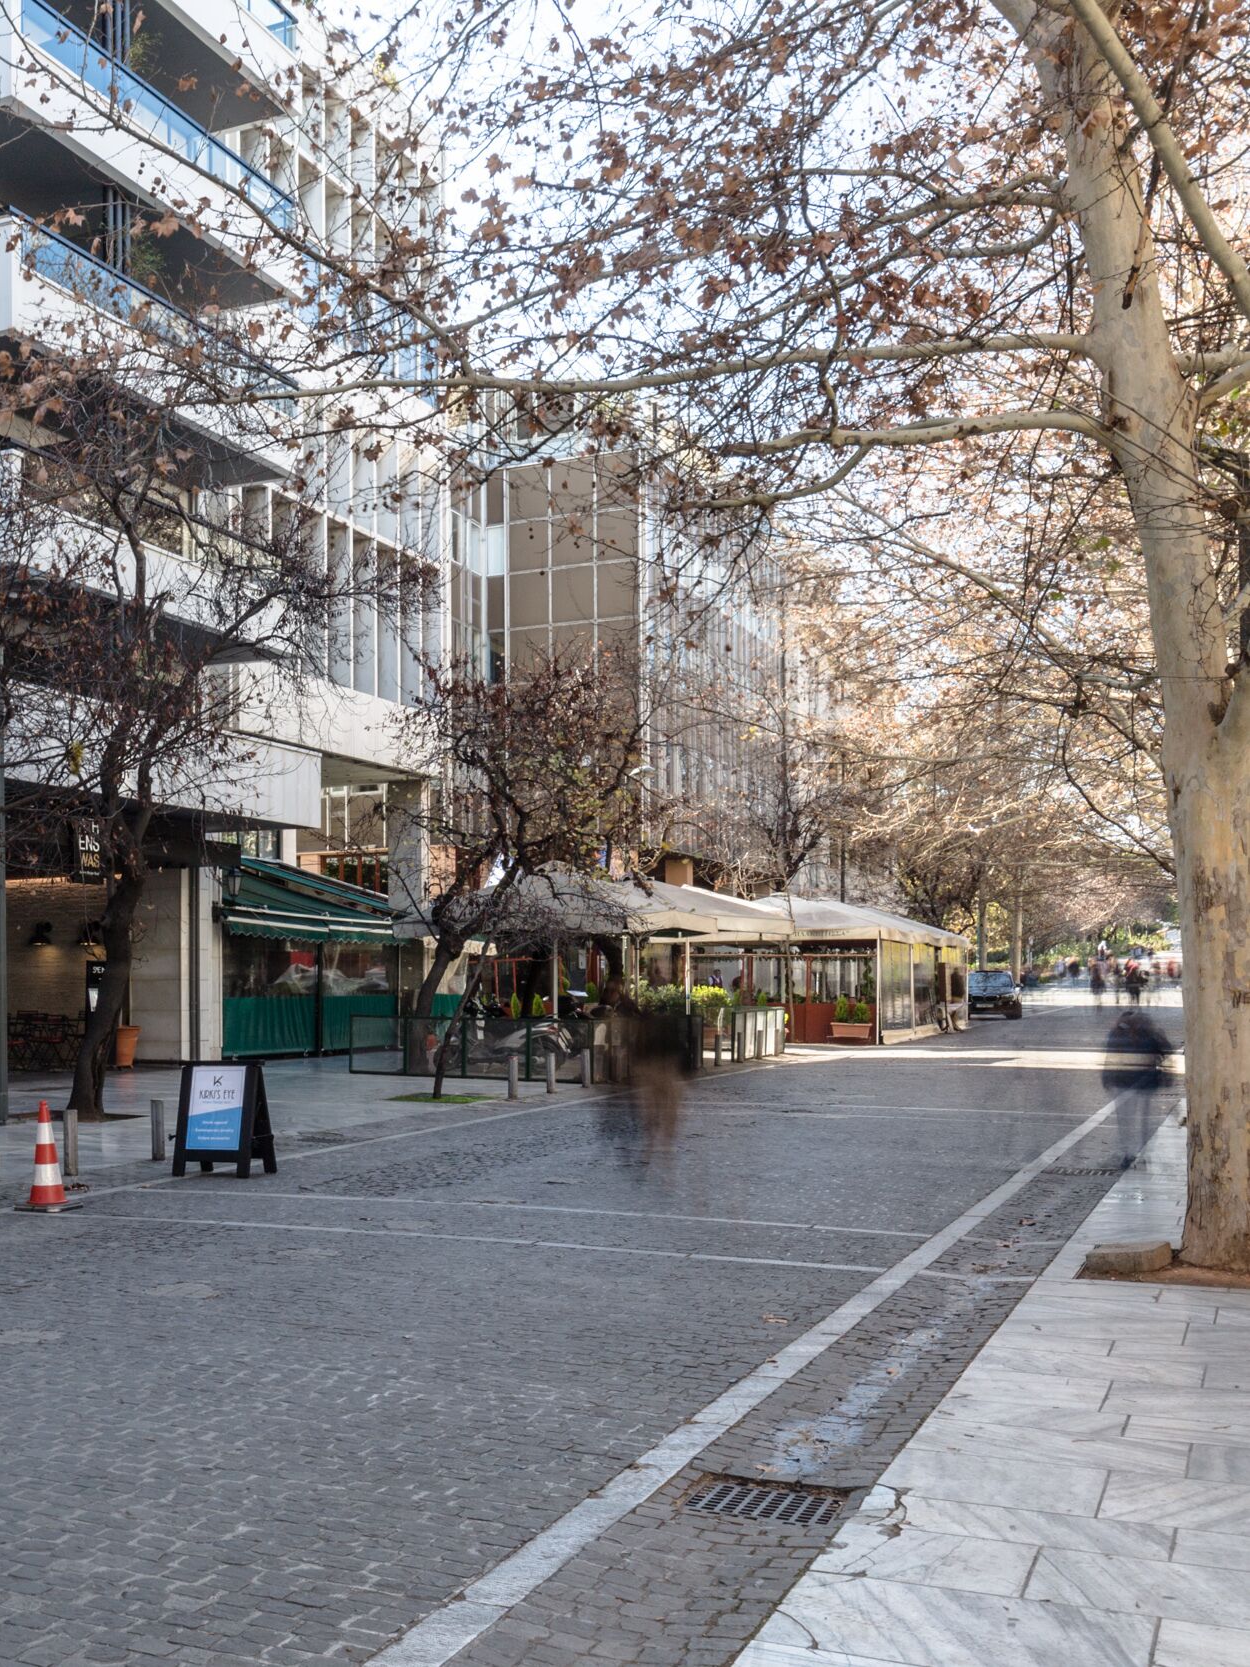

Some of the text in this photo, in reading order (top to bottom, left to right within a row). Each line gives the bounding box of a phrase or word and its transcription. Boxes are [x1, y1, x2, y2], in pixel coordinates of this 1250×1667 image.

[78, 834, 100, 852] ENS
[199, 1089, 236, 1100] KIRKI'S EYE
